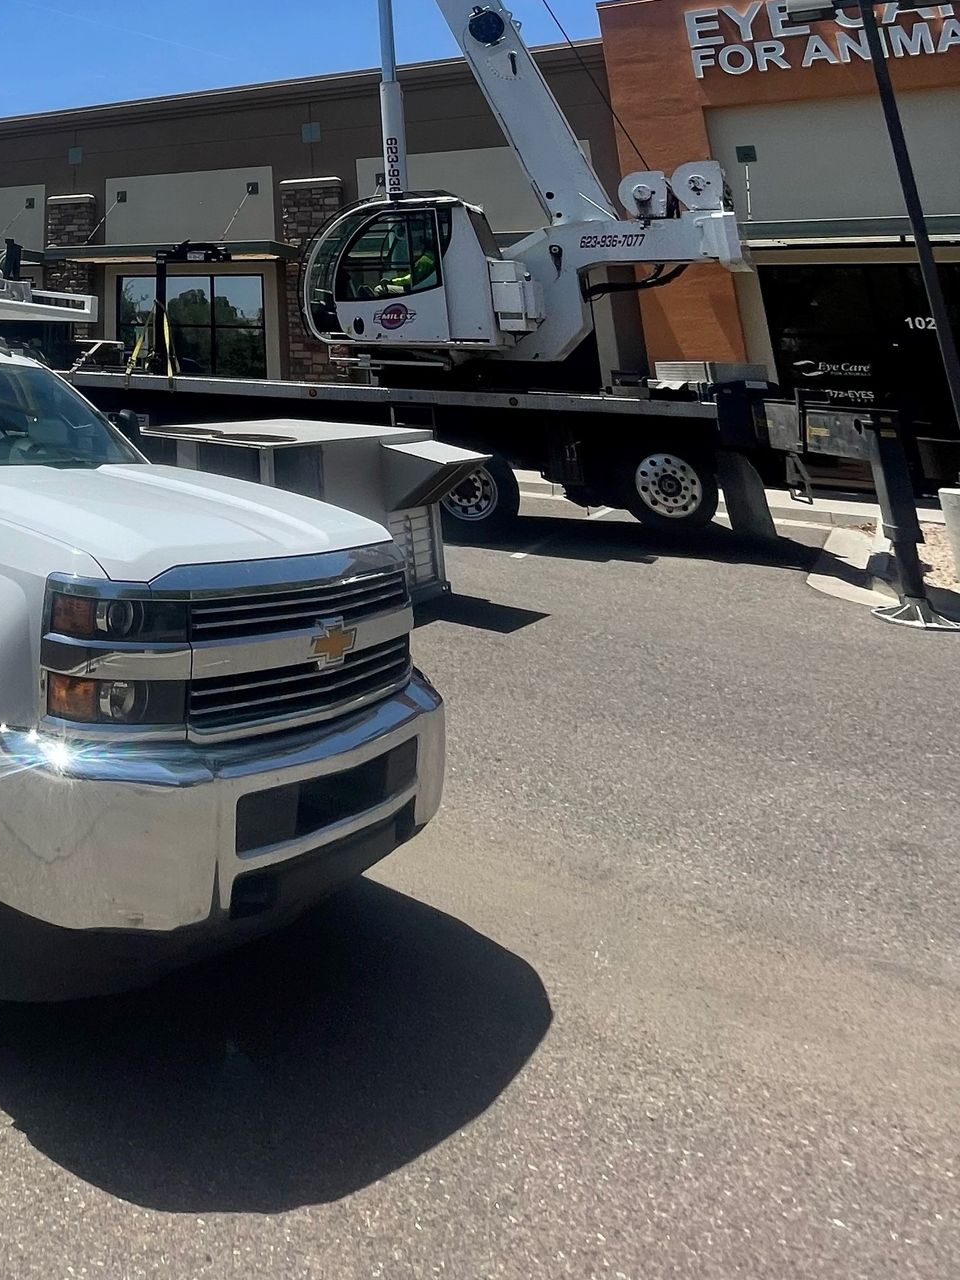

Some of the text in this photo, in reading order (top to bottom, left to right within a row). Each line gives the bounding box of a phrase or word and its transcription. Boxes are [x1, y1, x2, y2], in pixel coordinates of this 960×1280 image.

[691, 39, 792, 79] FOR
[580, 233, 646, 249] 623-936-7077
[904, 317, 938, 330] 102
[818, 361, 871, 373] Eye Care
